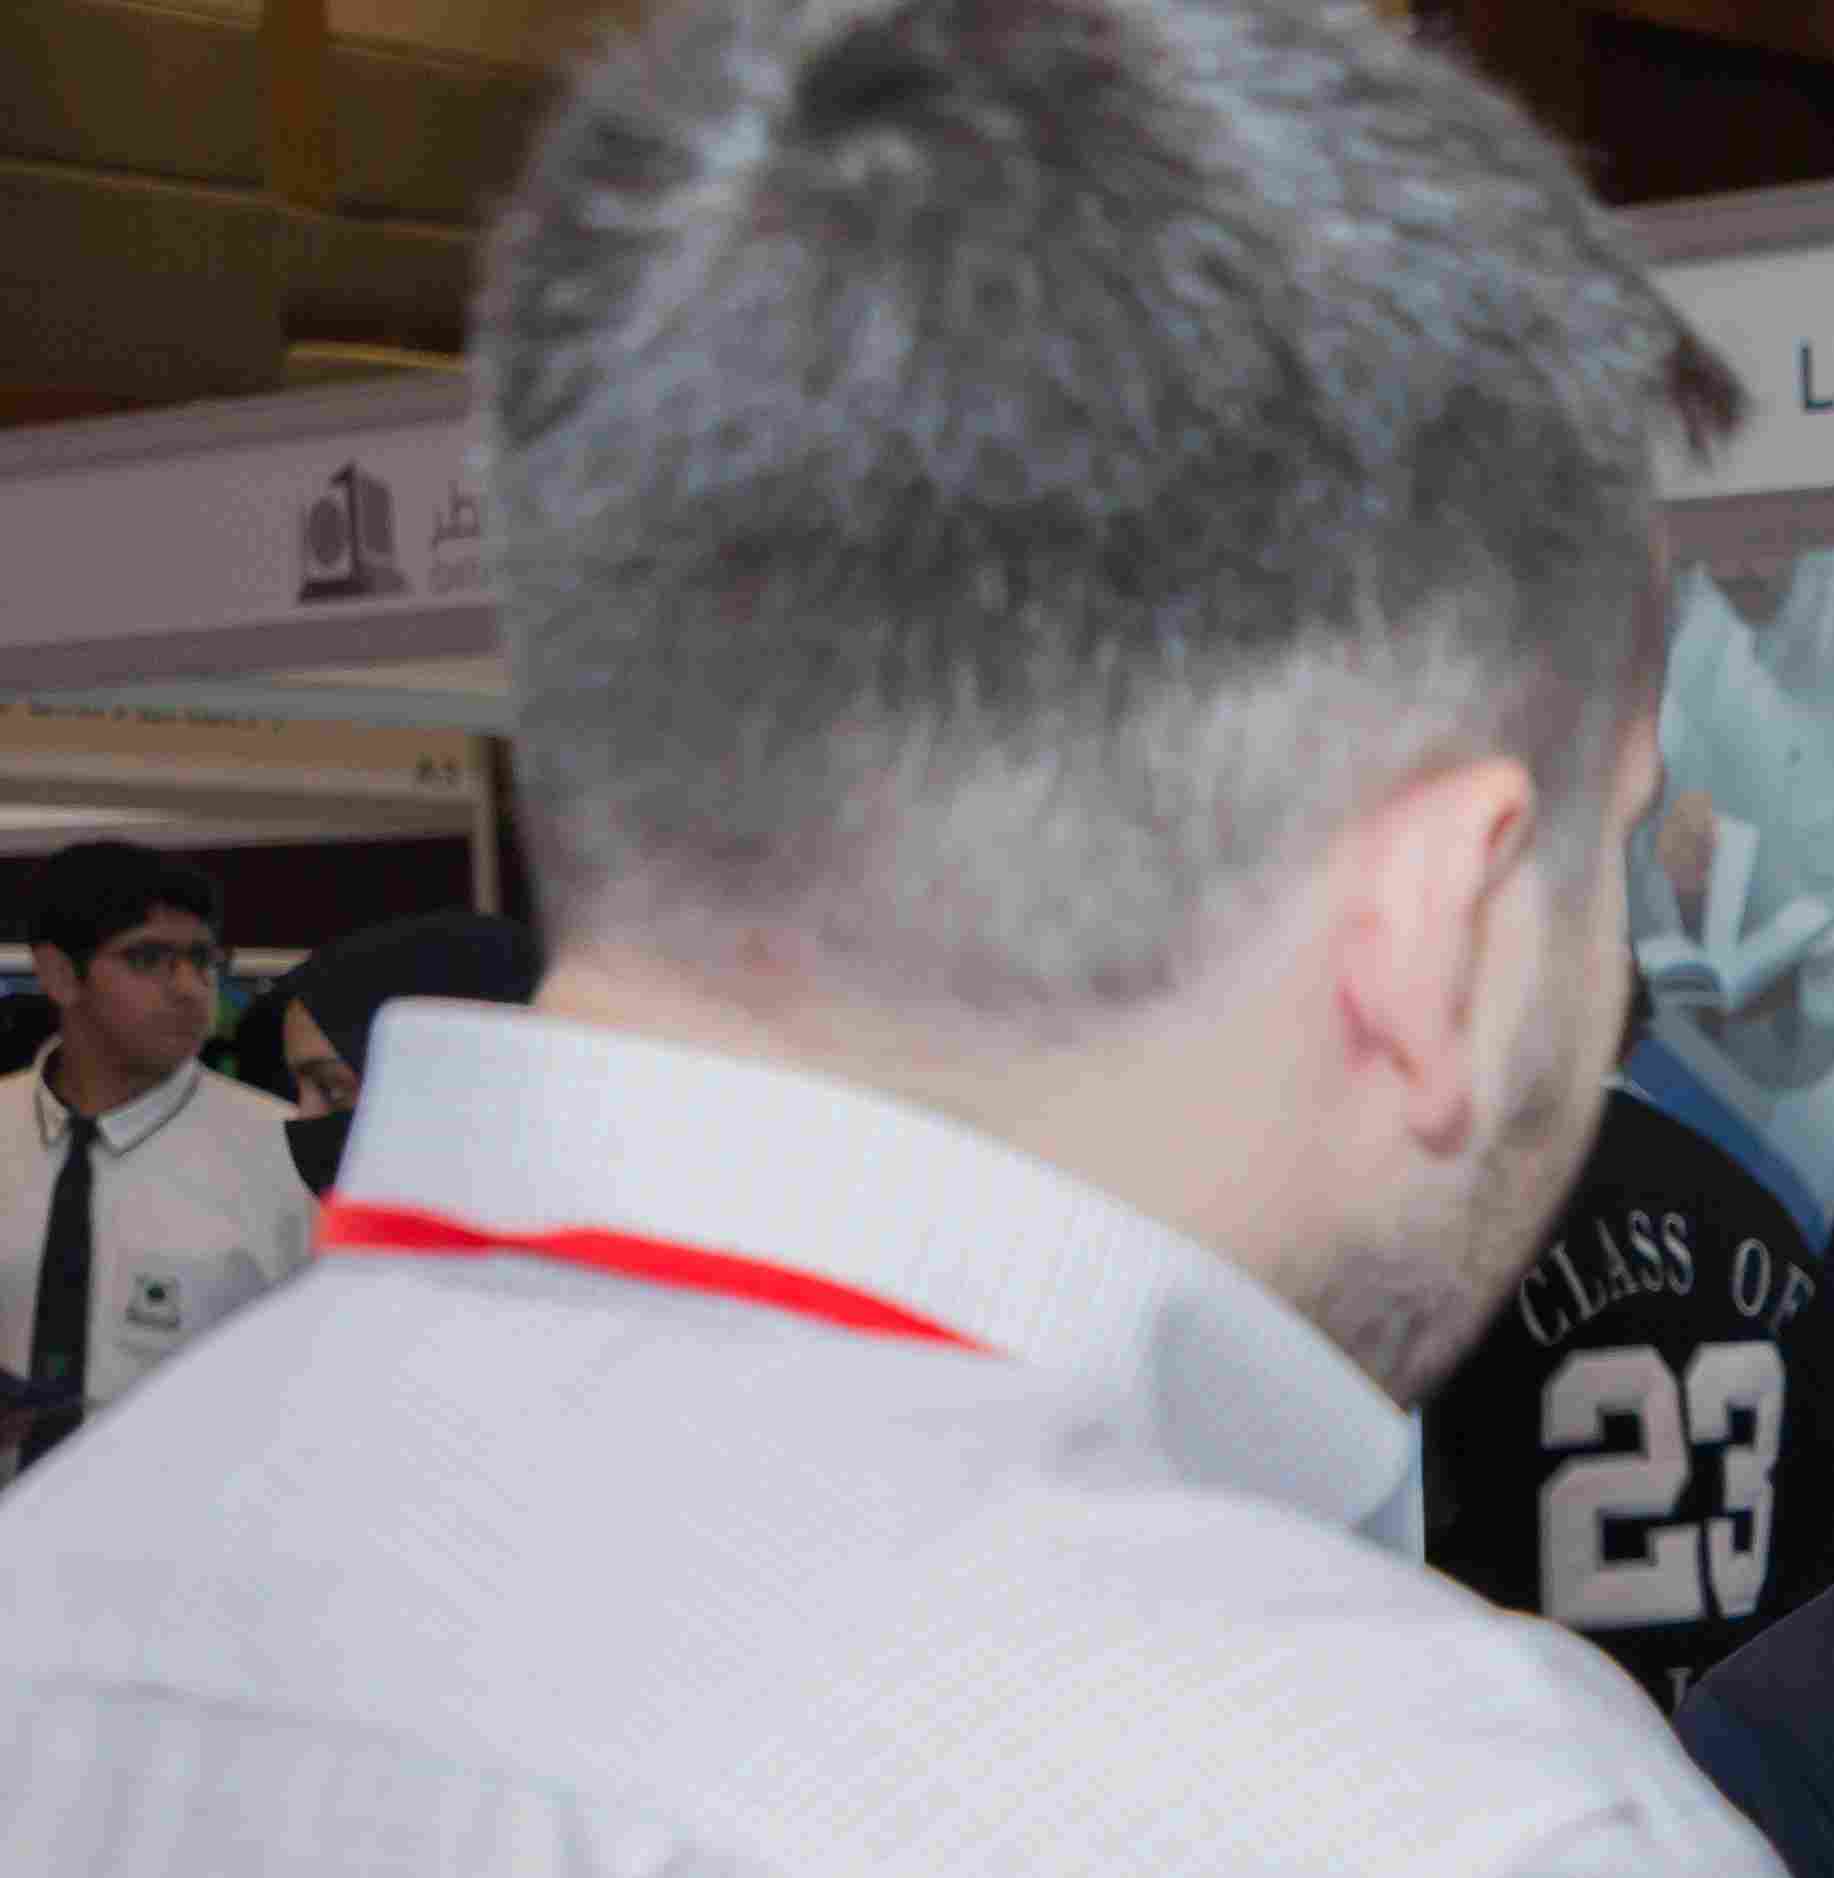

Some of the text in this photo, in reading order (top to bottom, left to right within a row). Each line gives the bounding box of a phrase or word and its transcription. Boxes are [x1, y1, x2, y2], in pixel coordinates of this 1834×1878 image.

[1517, 1207, 1817, 1347] CLASS OF
[1537, 1339, 1787, 1631] 23
